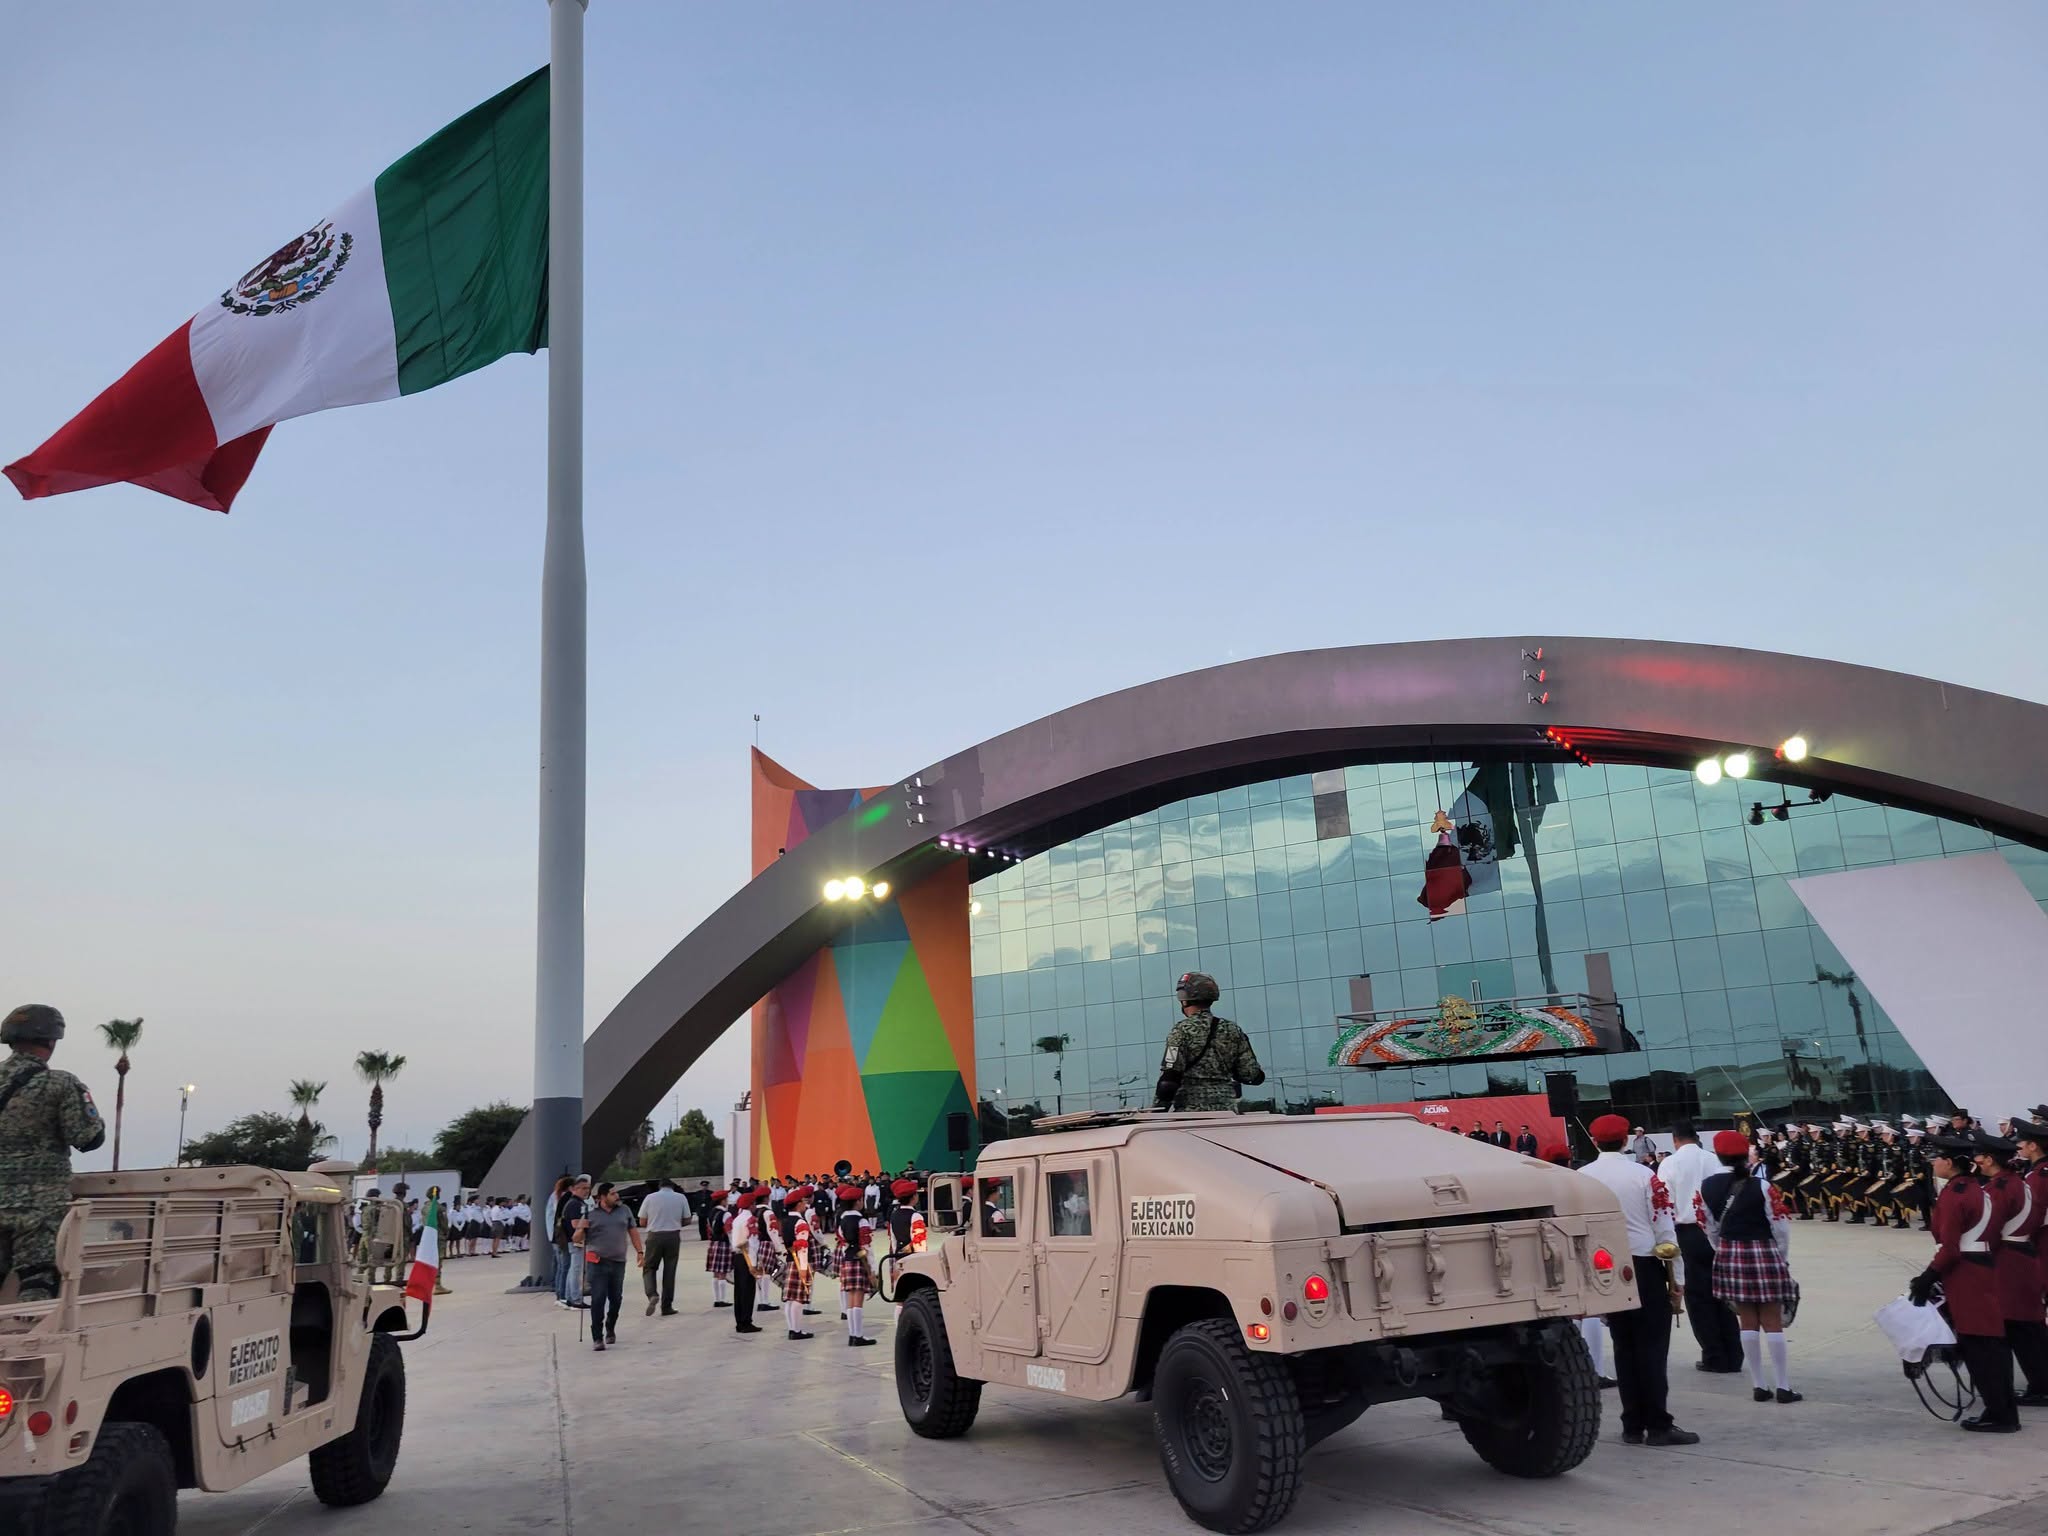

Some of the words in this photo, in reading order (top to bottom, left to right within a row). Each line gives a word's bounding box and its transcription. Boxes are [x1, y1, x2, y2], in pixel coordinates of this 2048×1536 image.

[1131, 1197, 1195, 1220] EJÉRCITO
[1131, 1221, 1194, 1236] MEXICANO
[230, 1335, 280, 1368] EJÉRCITO
[229, 1357, 277, 1386] MEXICANO
